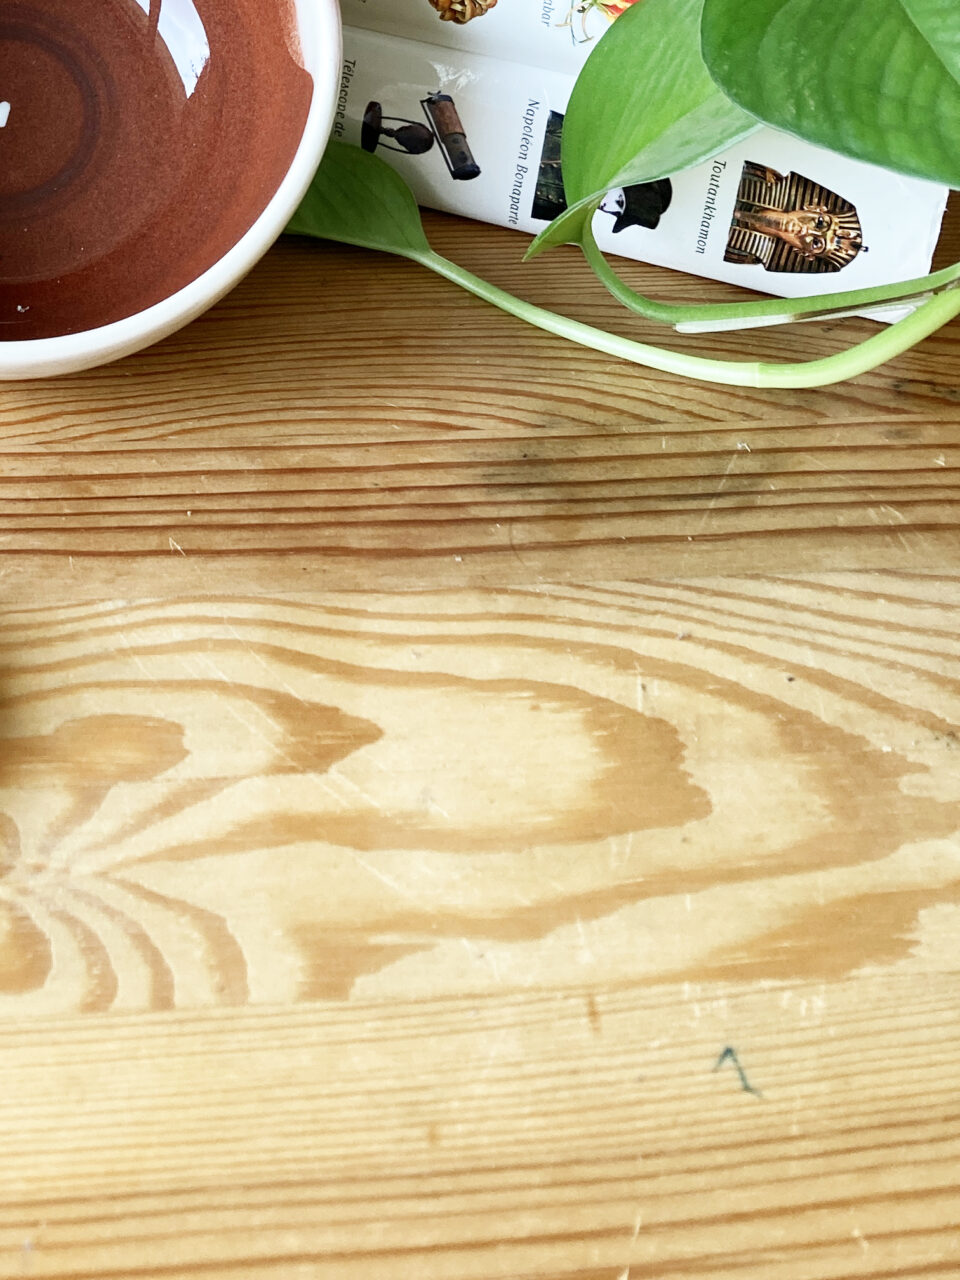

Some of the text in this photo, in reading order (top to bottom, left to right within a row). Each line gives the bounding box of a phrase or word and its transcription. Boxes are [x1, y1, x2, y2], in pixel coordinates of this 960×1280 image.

[508, 98, 540, 225] Napoléon Bonaparte
[695, 160, 727, 255] Toutankhamon
